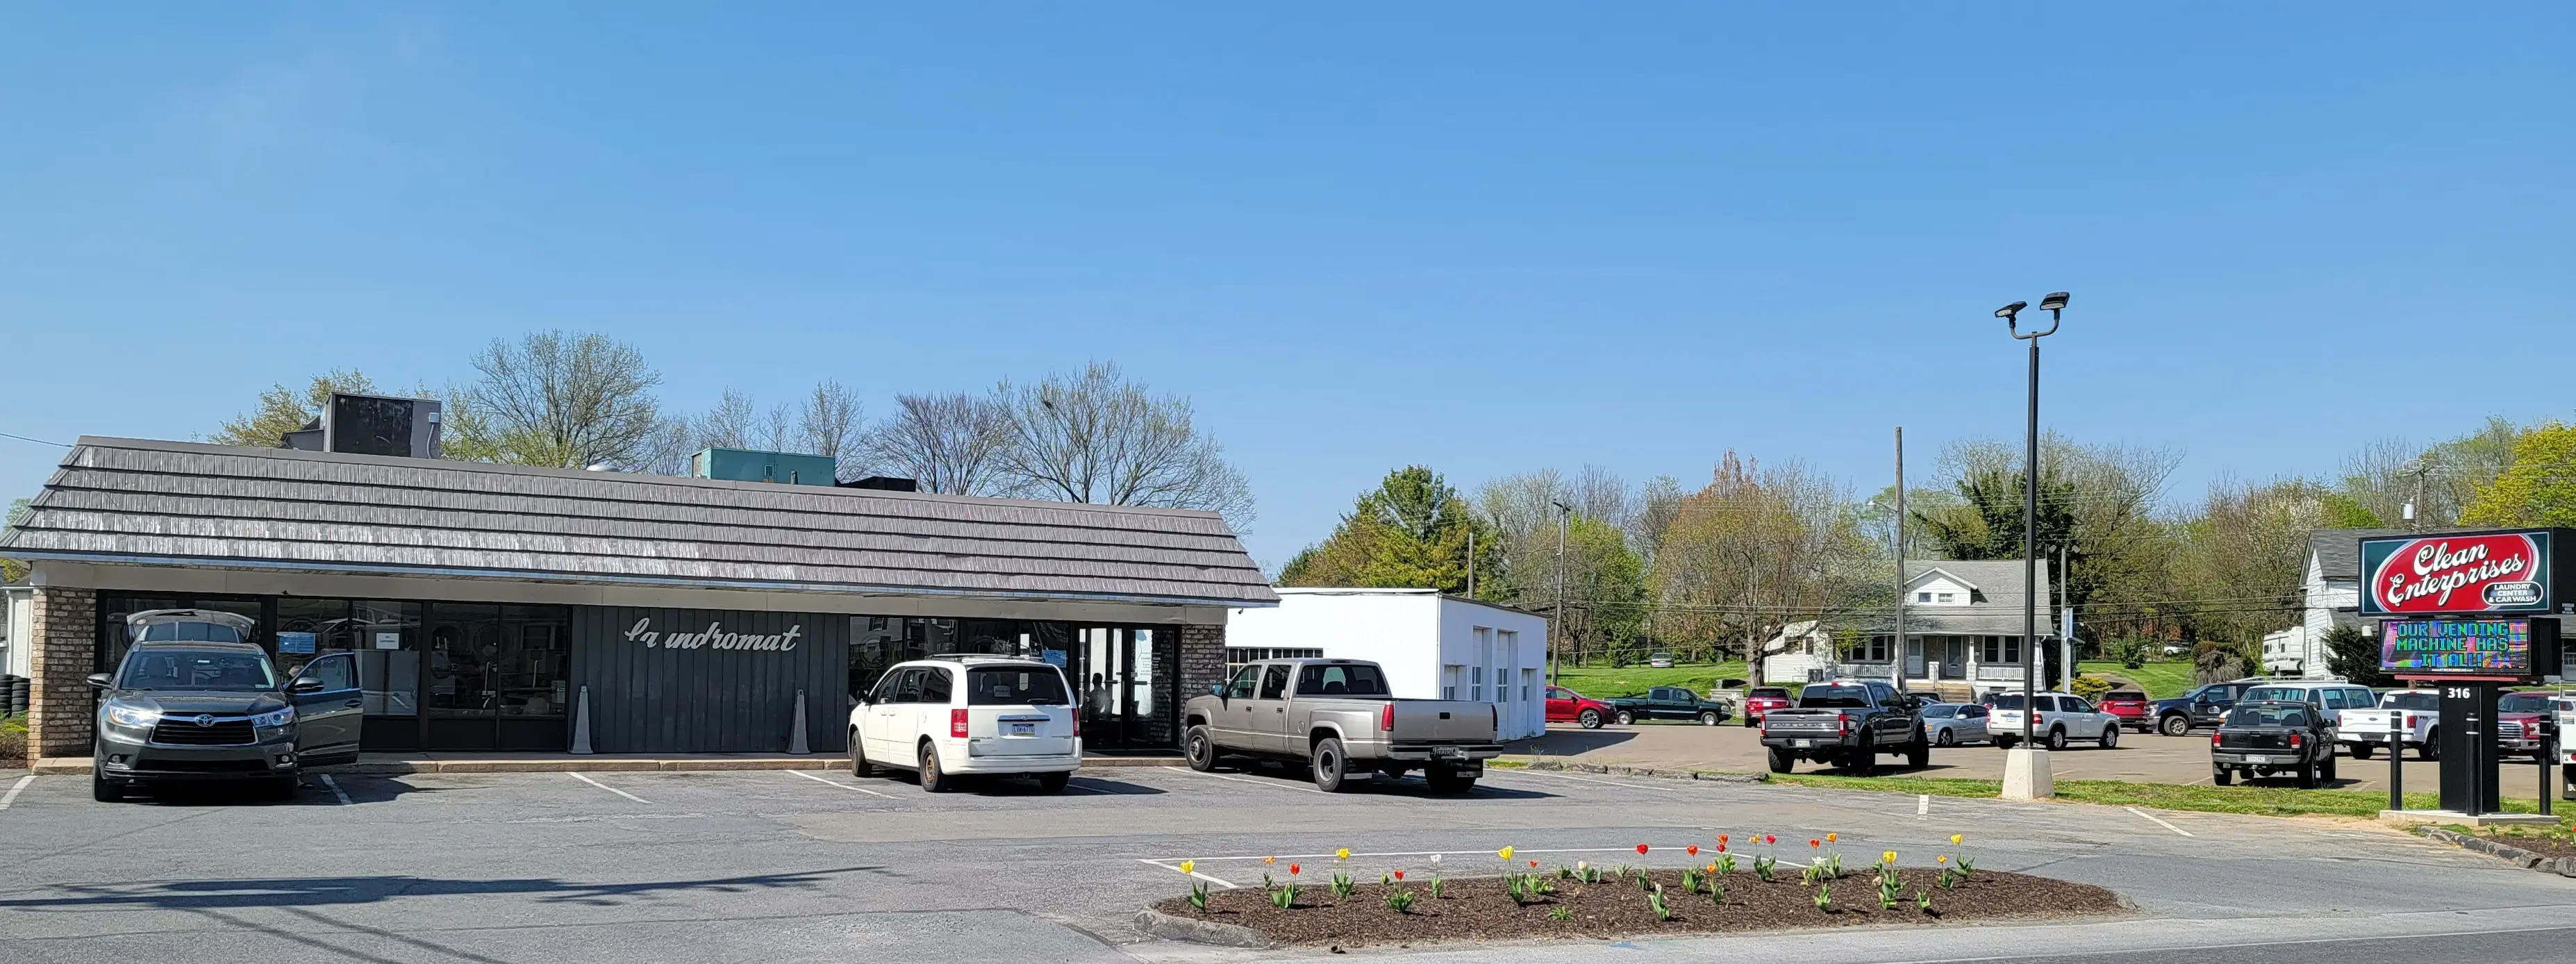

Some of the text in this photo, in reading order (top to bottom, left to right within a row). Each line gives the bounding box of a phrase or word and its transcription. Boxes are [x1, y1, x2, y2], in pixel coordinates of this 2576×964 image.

[2413, 542, 2488, 576] Clean
[2387, 553, 2526, 607] Enterprises
[2398, 622, 2509, 637] OUR VENDING
[2396, 636, 2508, 651] MACHINE HAS
[2421, 653, 2483, 667] IT ALL!
[2448, 688, 2470, 699] 316
